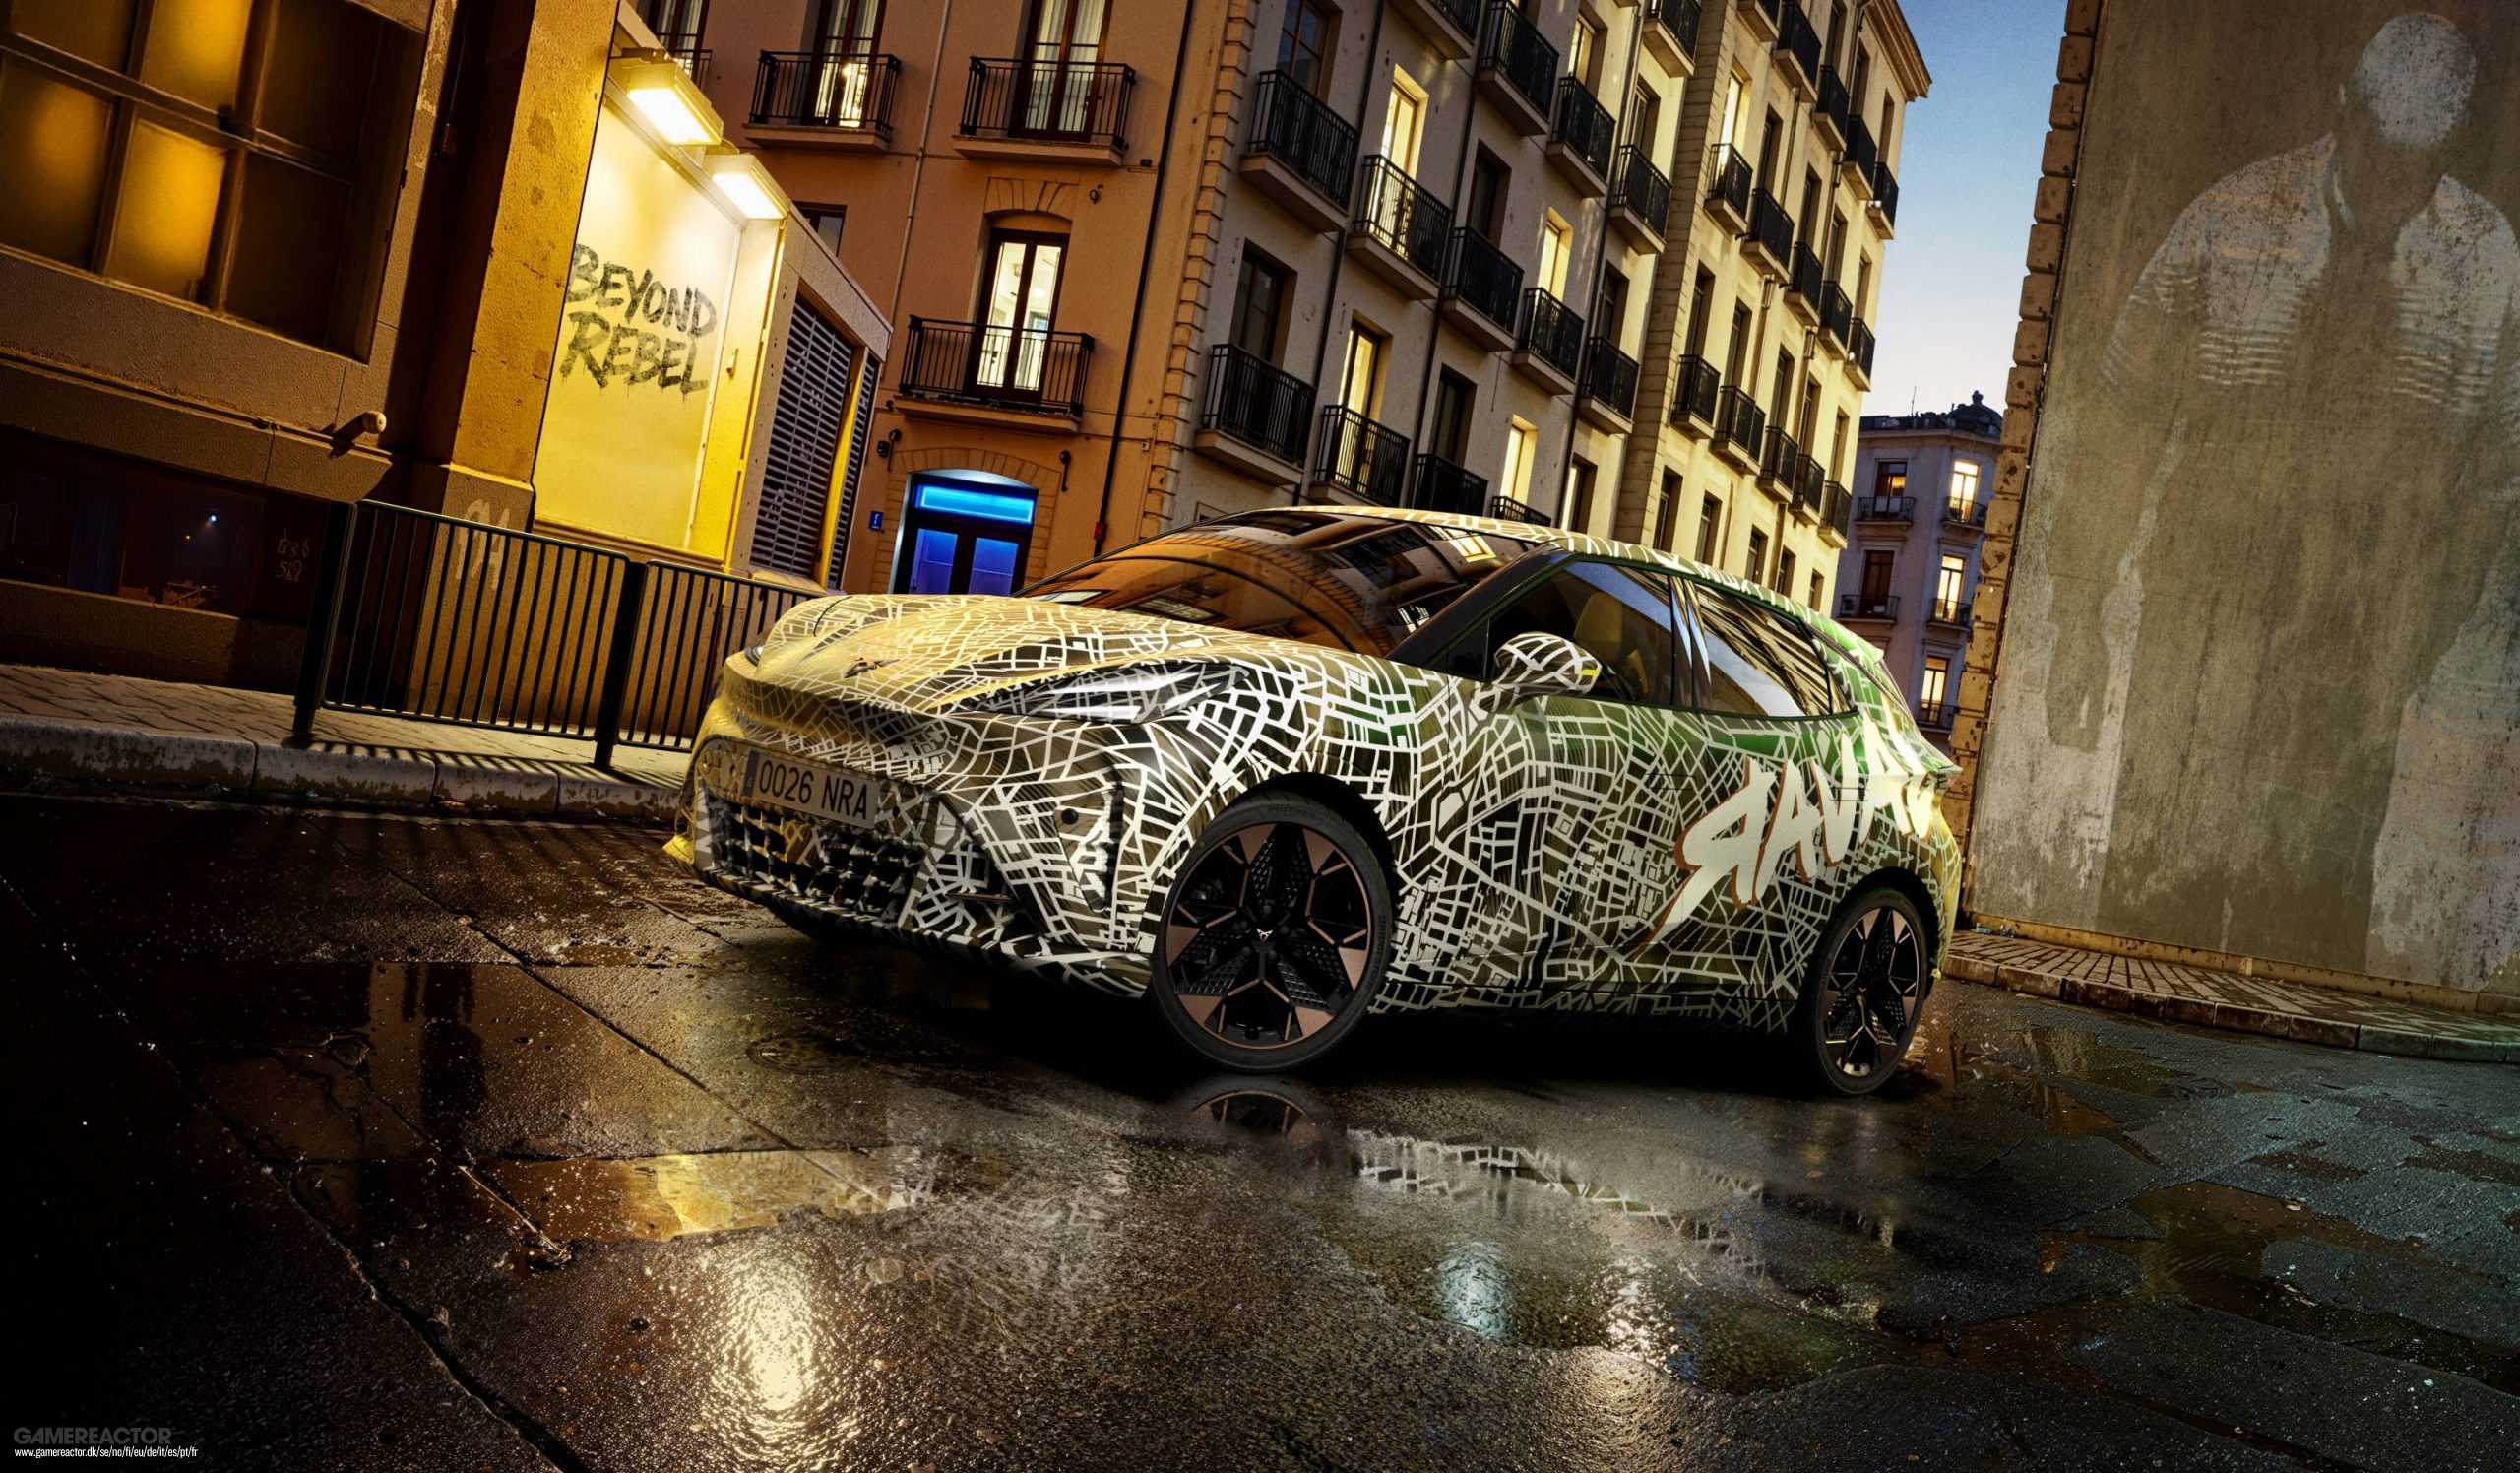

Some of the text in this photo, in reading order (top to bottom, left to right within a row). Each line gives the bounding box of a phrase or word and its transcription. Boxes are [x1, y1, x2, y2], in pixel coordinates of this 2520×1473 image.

[565, 243, 718, 338] BEYOND
[559, 310, 710, 396] REBEL
[759, 760, 868, 820] 0026 NRA
